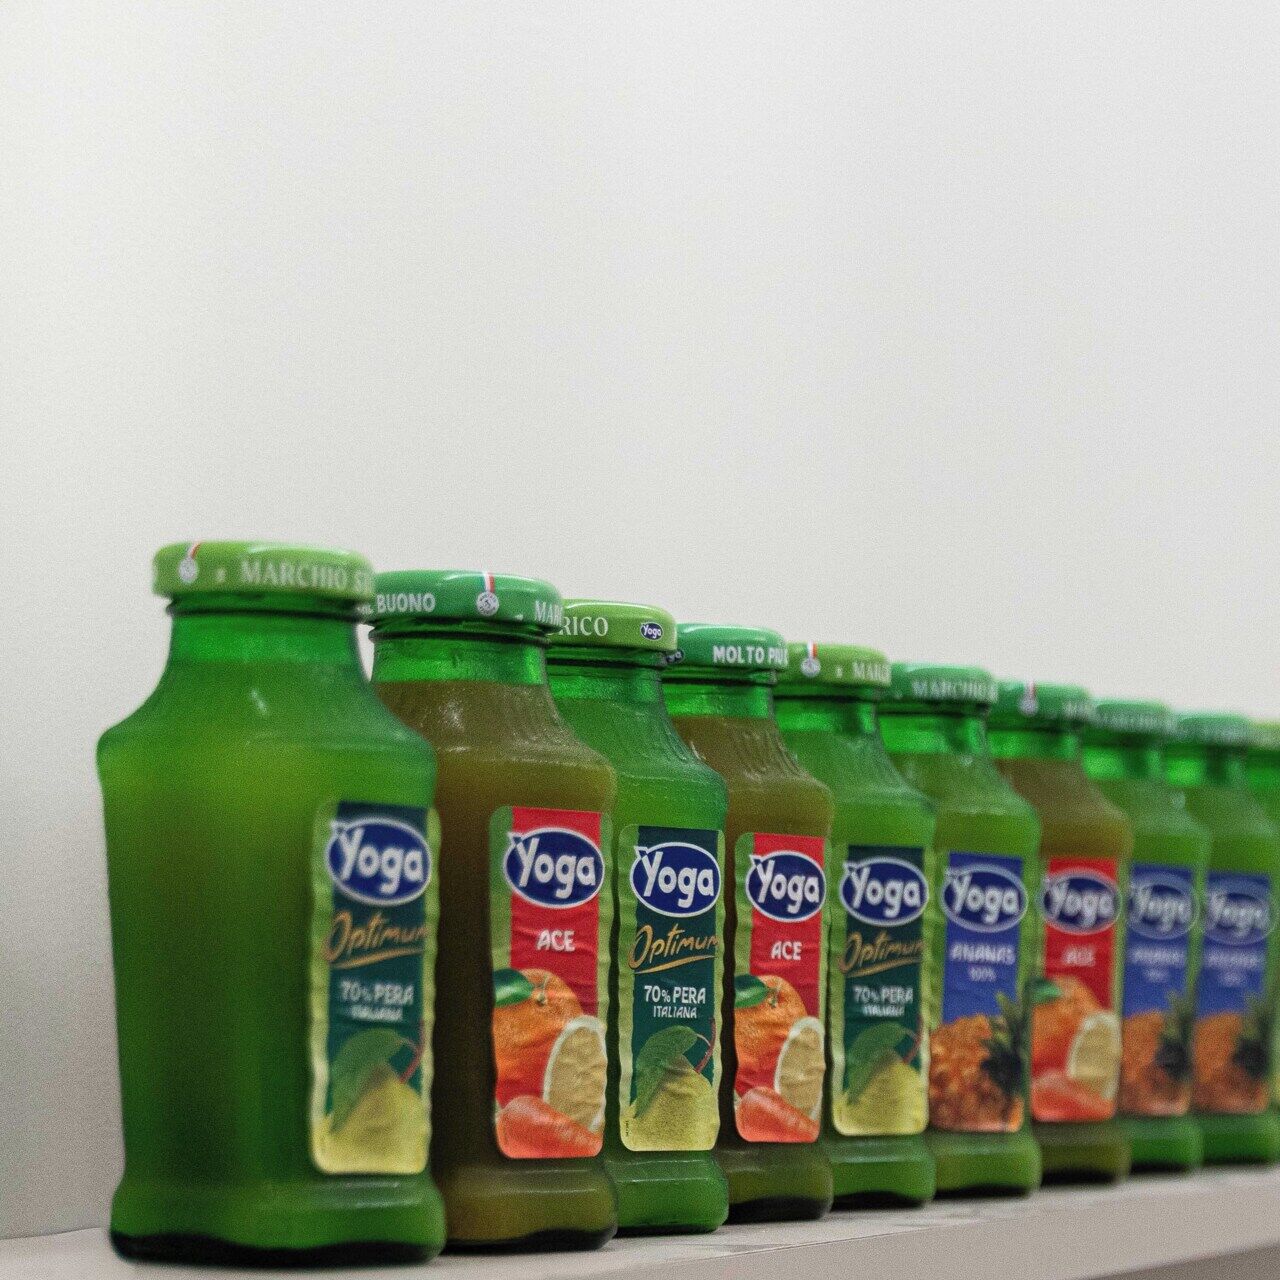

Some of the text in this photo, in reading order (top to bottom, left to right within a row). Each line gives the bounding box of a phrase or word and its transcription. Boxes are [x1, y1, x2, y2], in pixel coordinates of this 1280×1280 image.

[376, 592, 436, 613] BUONO
[713, 645, 764, 665] MOLTO
[338, 826, 425, 894] Yoga
[517, 836, 597, 899] Yoga
[642, 850, 716, 909] Yoga
[756, 858, 821, 914] Yoga
[850, 866, 921, 918] Yoga
[950, 873, 1021, 925] Yoga
[537, 929, 576, 952] ACE
[628, 923, 719, 971] Optimum
[771, 941, 803, 961] ACE
[644, 985, 706, 1005] 70% PERA
[653, 1005, 698, 1020] ITALIANA
